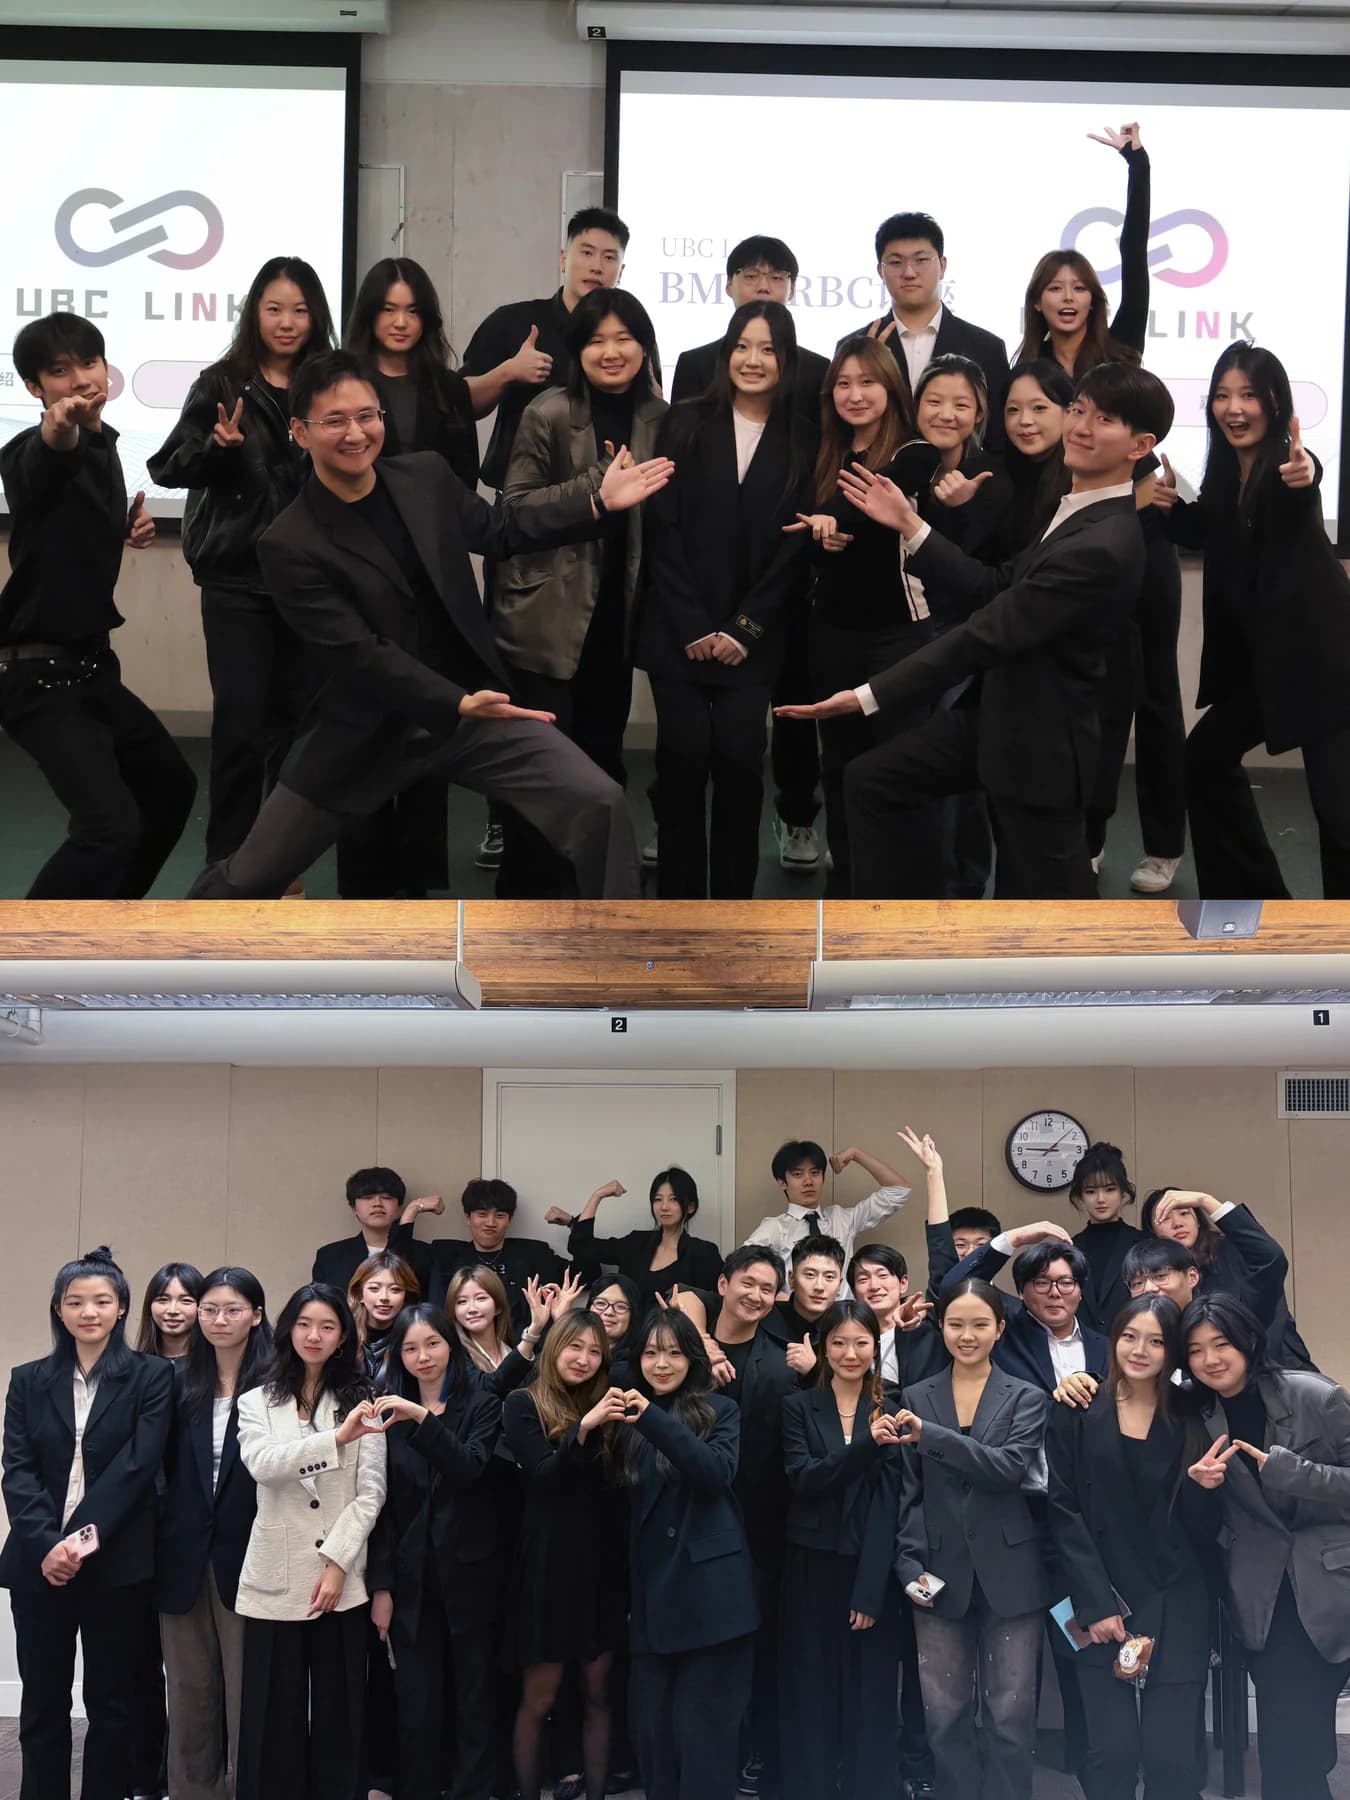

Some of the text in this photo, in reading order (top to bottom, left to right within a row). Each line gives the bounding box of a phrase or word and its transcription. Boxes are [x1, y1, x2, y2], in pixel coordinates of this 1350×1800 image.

[661, 236, 713, 258] UBC
[659, 271, 725, 304] BM
[16, 288, 108, 319] UBC
[1148, 309, 1254, 340] LINK
[1031, 1121, 1038, 1131] 11
[1044, 1117, 1053, 1127] 12
[1020, 1132, 1029, 1141] 10
[1071, 1131, 1078, 1140] 2
[1017, 1147, 1023, 1155] 9
[1076, 1146, 1082, 1154] 3
[1021, 1160, 1027, 1169] 8
[1032, 1170, 1038, 1179] 7
[1061, 1169, 1068, 1178] 5
[1046, 1174, 1053, 1183] 6
